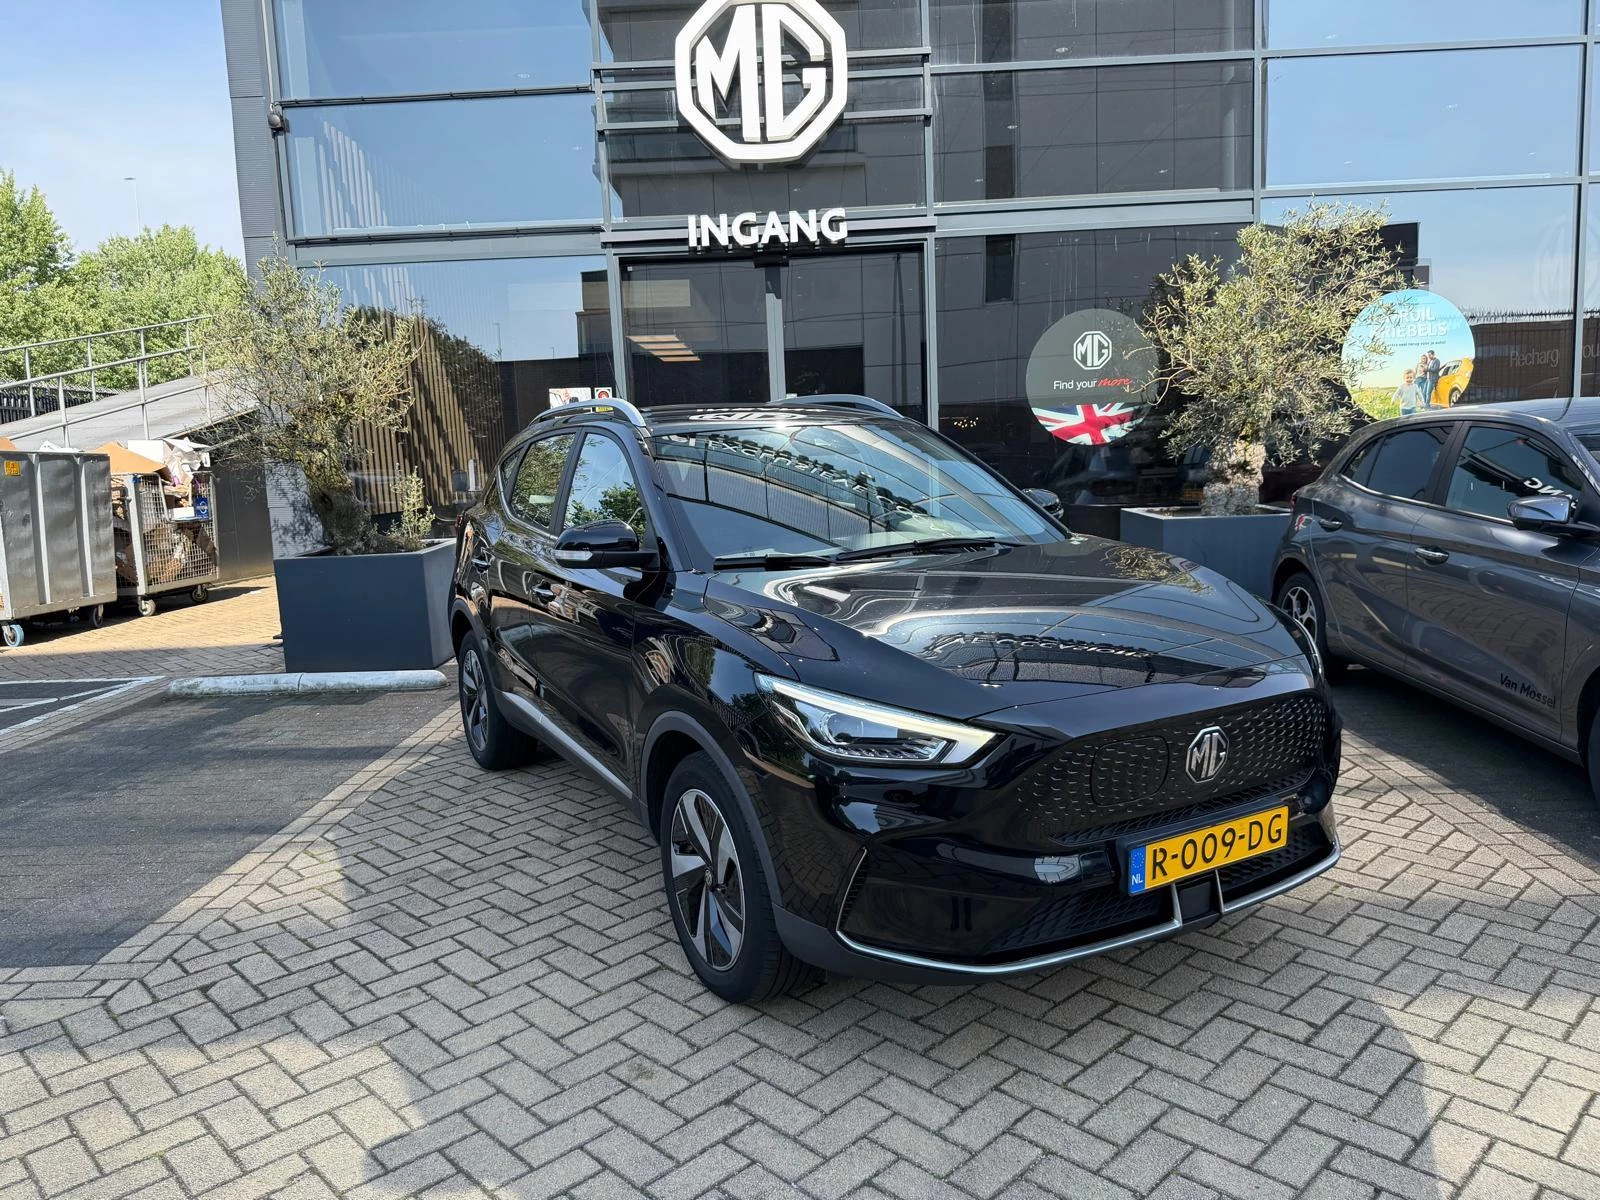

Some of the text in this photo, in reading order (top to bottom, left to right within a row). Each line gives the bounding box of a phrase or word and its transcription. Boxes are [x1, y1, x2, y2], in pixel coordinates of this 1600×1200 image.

[695, 2, 828, 143] MG
[688, 207, 848, 247] INGANG
[1374, 321, 1448, 338] RIEBELS
[1076, 333, 1109, 368] MG
[1053, 377, 1133, 391] Find your more
[1500, 672, 1556, 709] Van Mossel
[1190, 732, 1227, 779] MG
[1152, 813, 1282, 880] R-009-DG
[1131, 873, 1144, 886] NL
